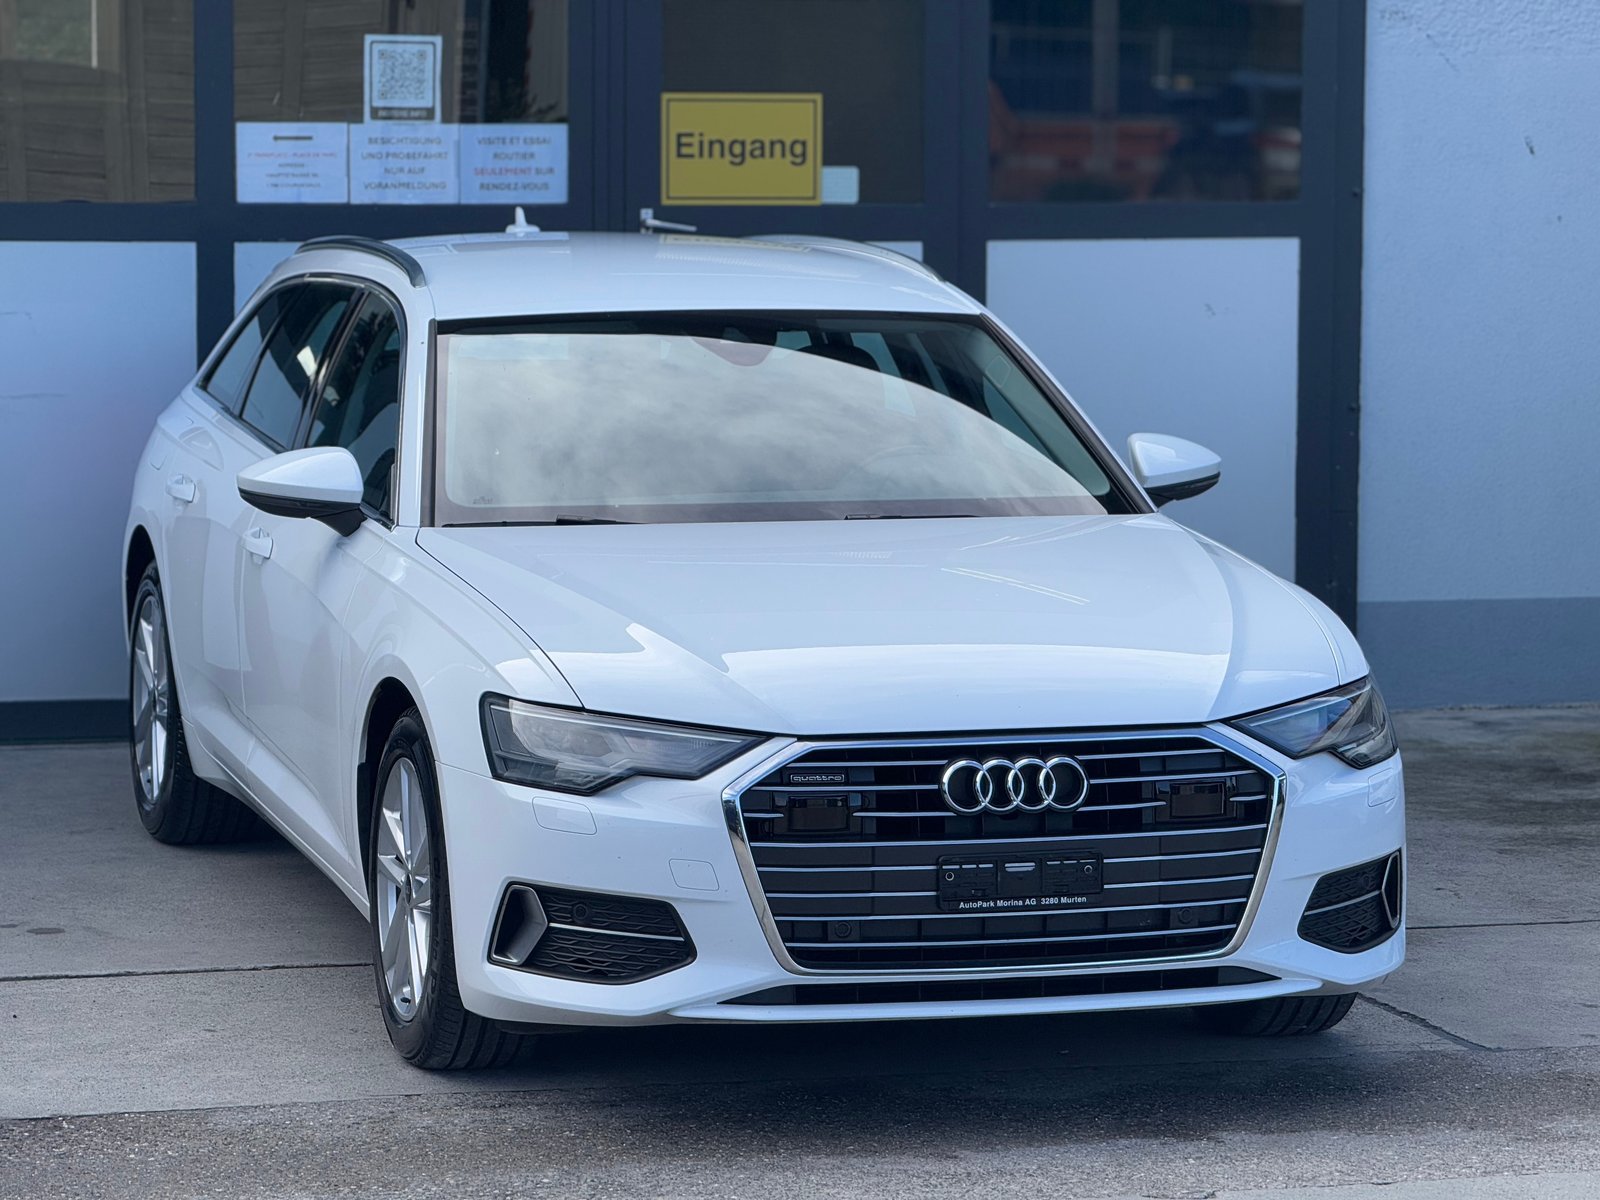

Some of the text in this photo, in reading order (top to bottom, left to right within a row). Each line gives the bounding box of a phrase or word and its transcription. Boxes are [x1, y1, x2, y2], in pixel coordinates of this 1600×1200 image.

[367, 136, 442, 145] BESICHTIGUNG
[476, 136, 552, 145] VISITE ET ESSAI
[675, 132, 808, 167] Eingang
[361, 151, 448, 160] UND PROBEFAHRT
[493, 151, 536, 160] ROUTIER
[384, 166, 426, 175] NUR AUF
[473, 167, 555, 176] SEULEMENT SUR
[362, 181, 447, 190] VORANMELDUNG
[479, 181, 550, 191] RENDEZ-VOUS
[958, 896, 1087, 909] AutoPark Morina AG 3280 Murten
